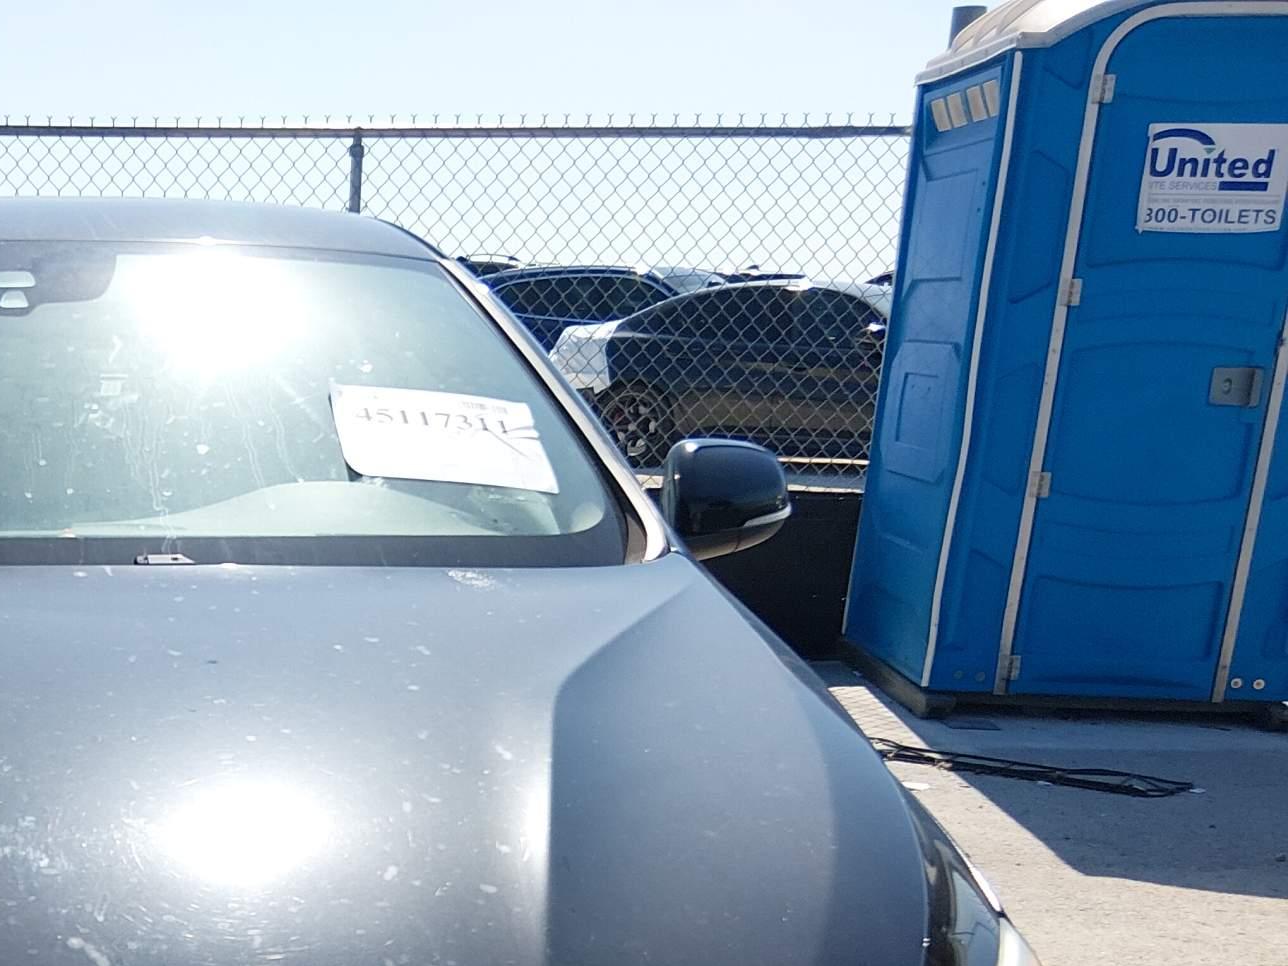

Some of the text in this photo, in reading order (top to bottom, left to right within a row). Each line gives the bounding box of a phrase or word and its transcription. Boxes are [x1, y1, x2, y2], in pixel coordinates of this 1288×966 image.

[1149, 147, 1276, 179] United
[1168, 181, 1216, 191] SERVICES
[355, 407, 508, 434] 45117311
